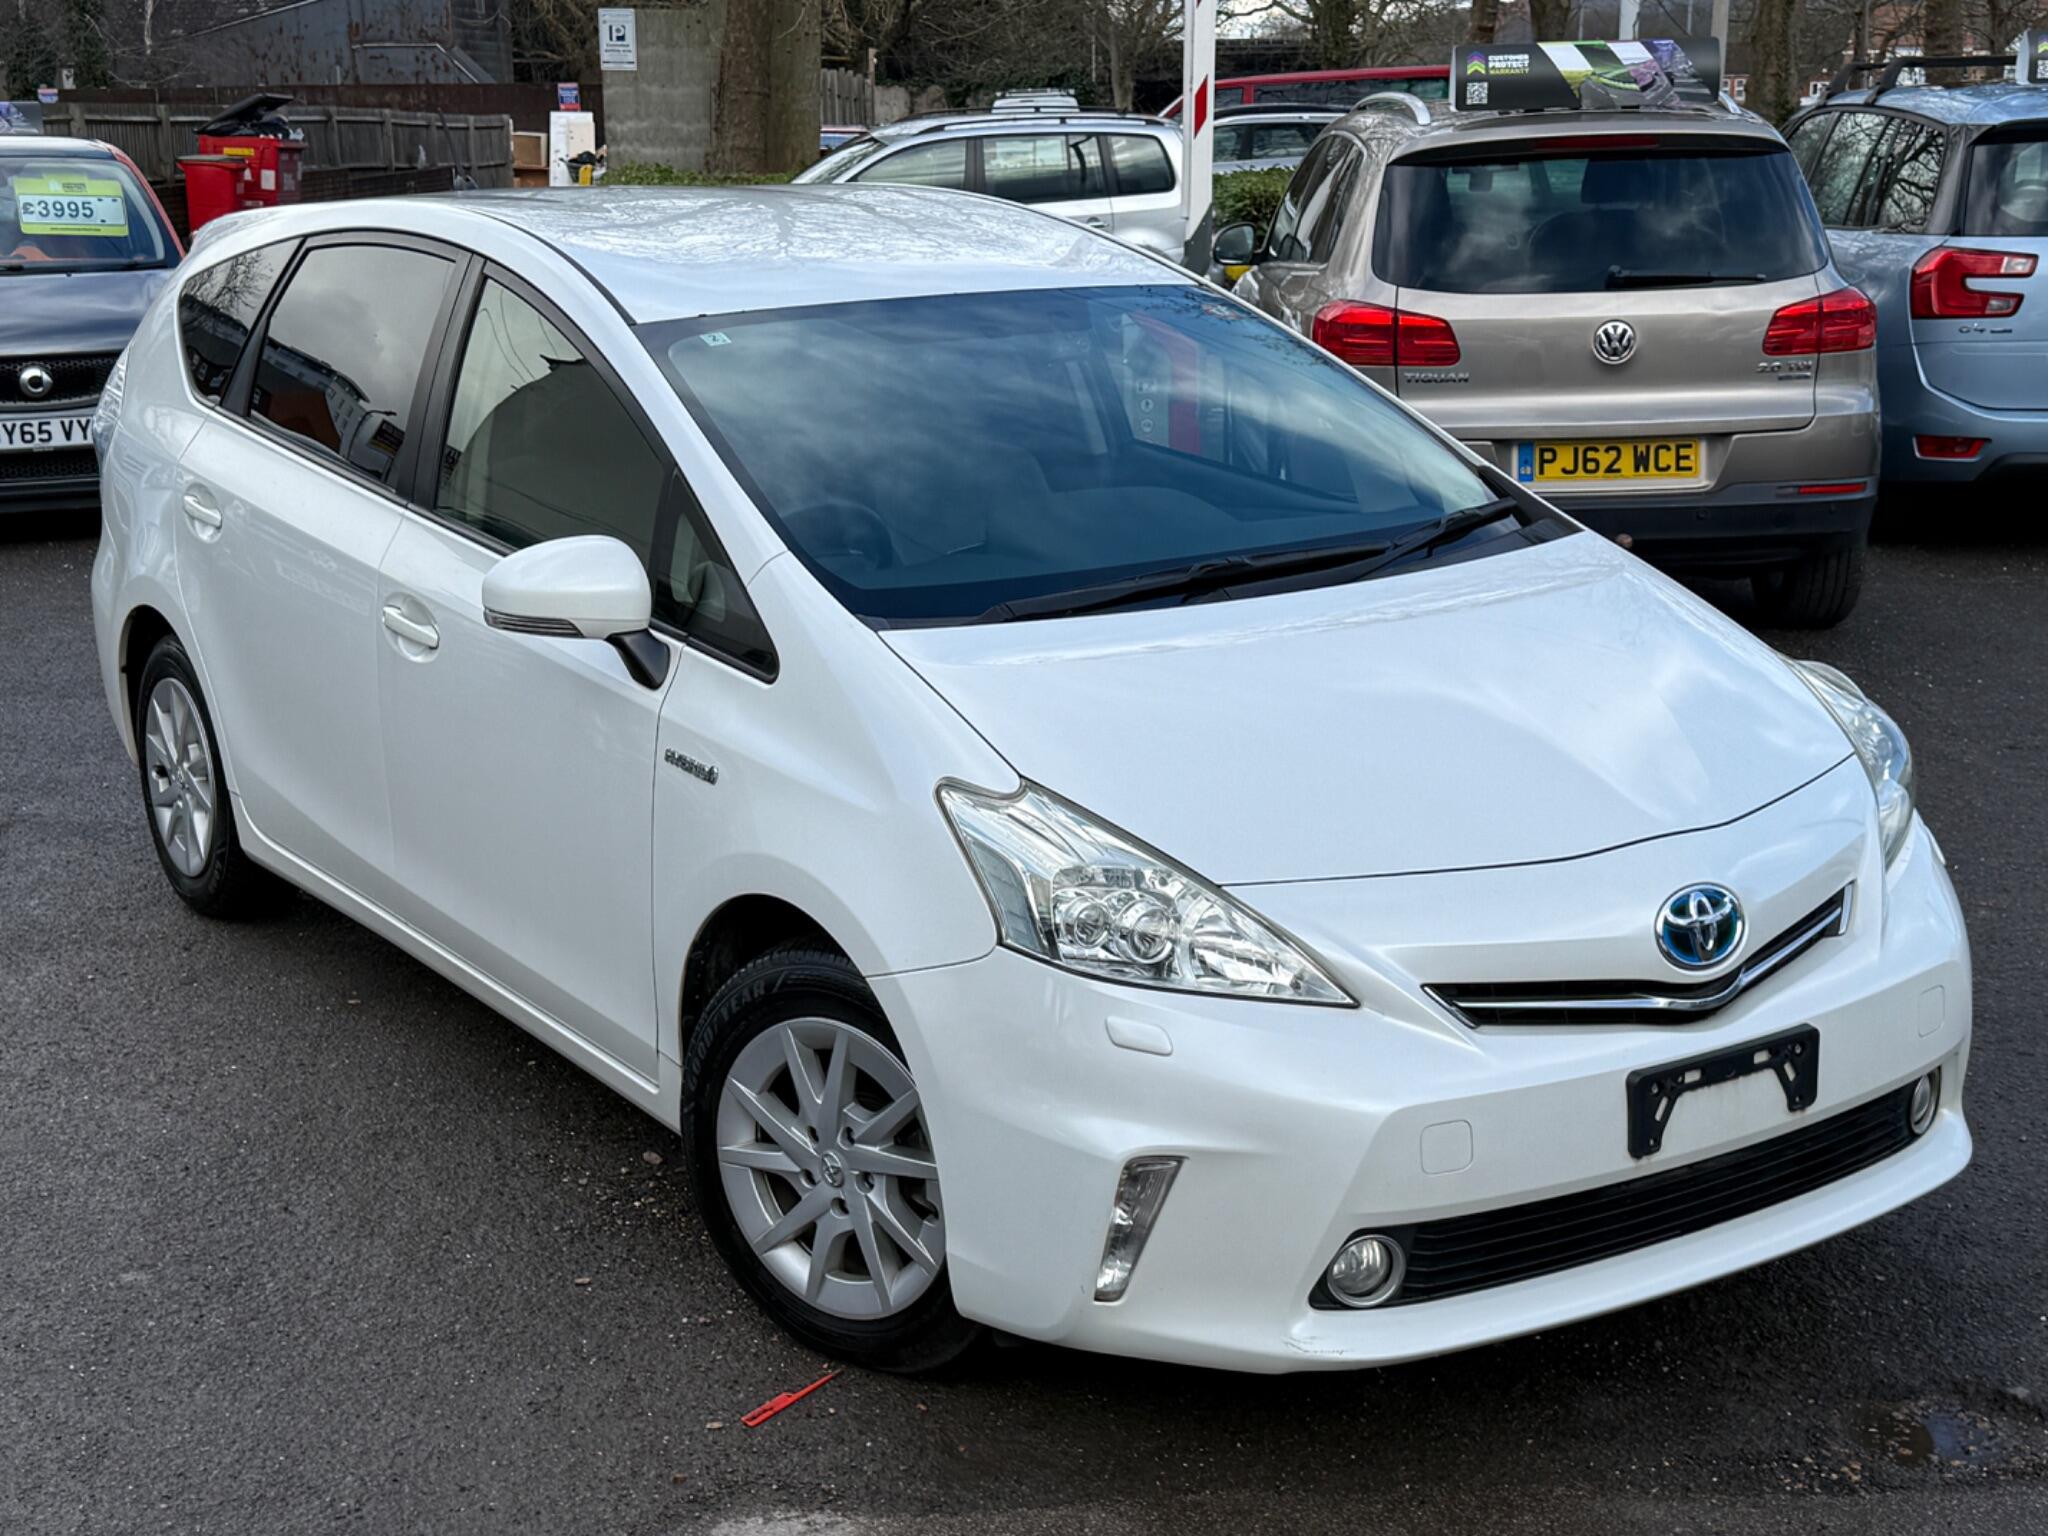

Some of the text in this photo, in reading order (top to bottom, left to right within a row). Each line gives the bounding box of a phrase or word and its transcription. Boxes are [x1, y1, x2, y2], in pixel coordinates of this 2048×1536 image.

[22, 200, 94, 219] £3995
[0, 418, 91, 445] Y65 VY
[1537, 443, 1693, 476] PJ62 WCE
